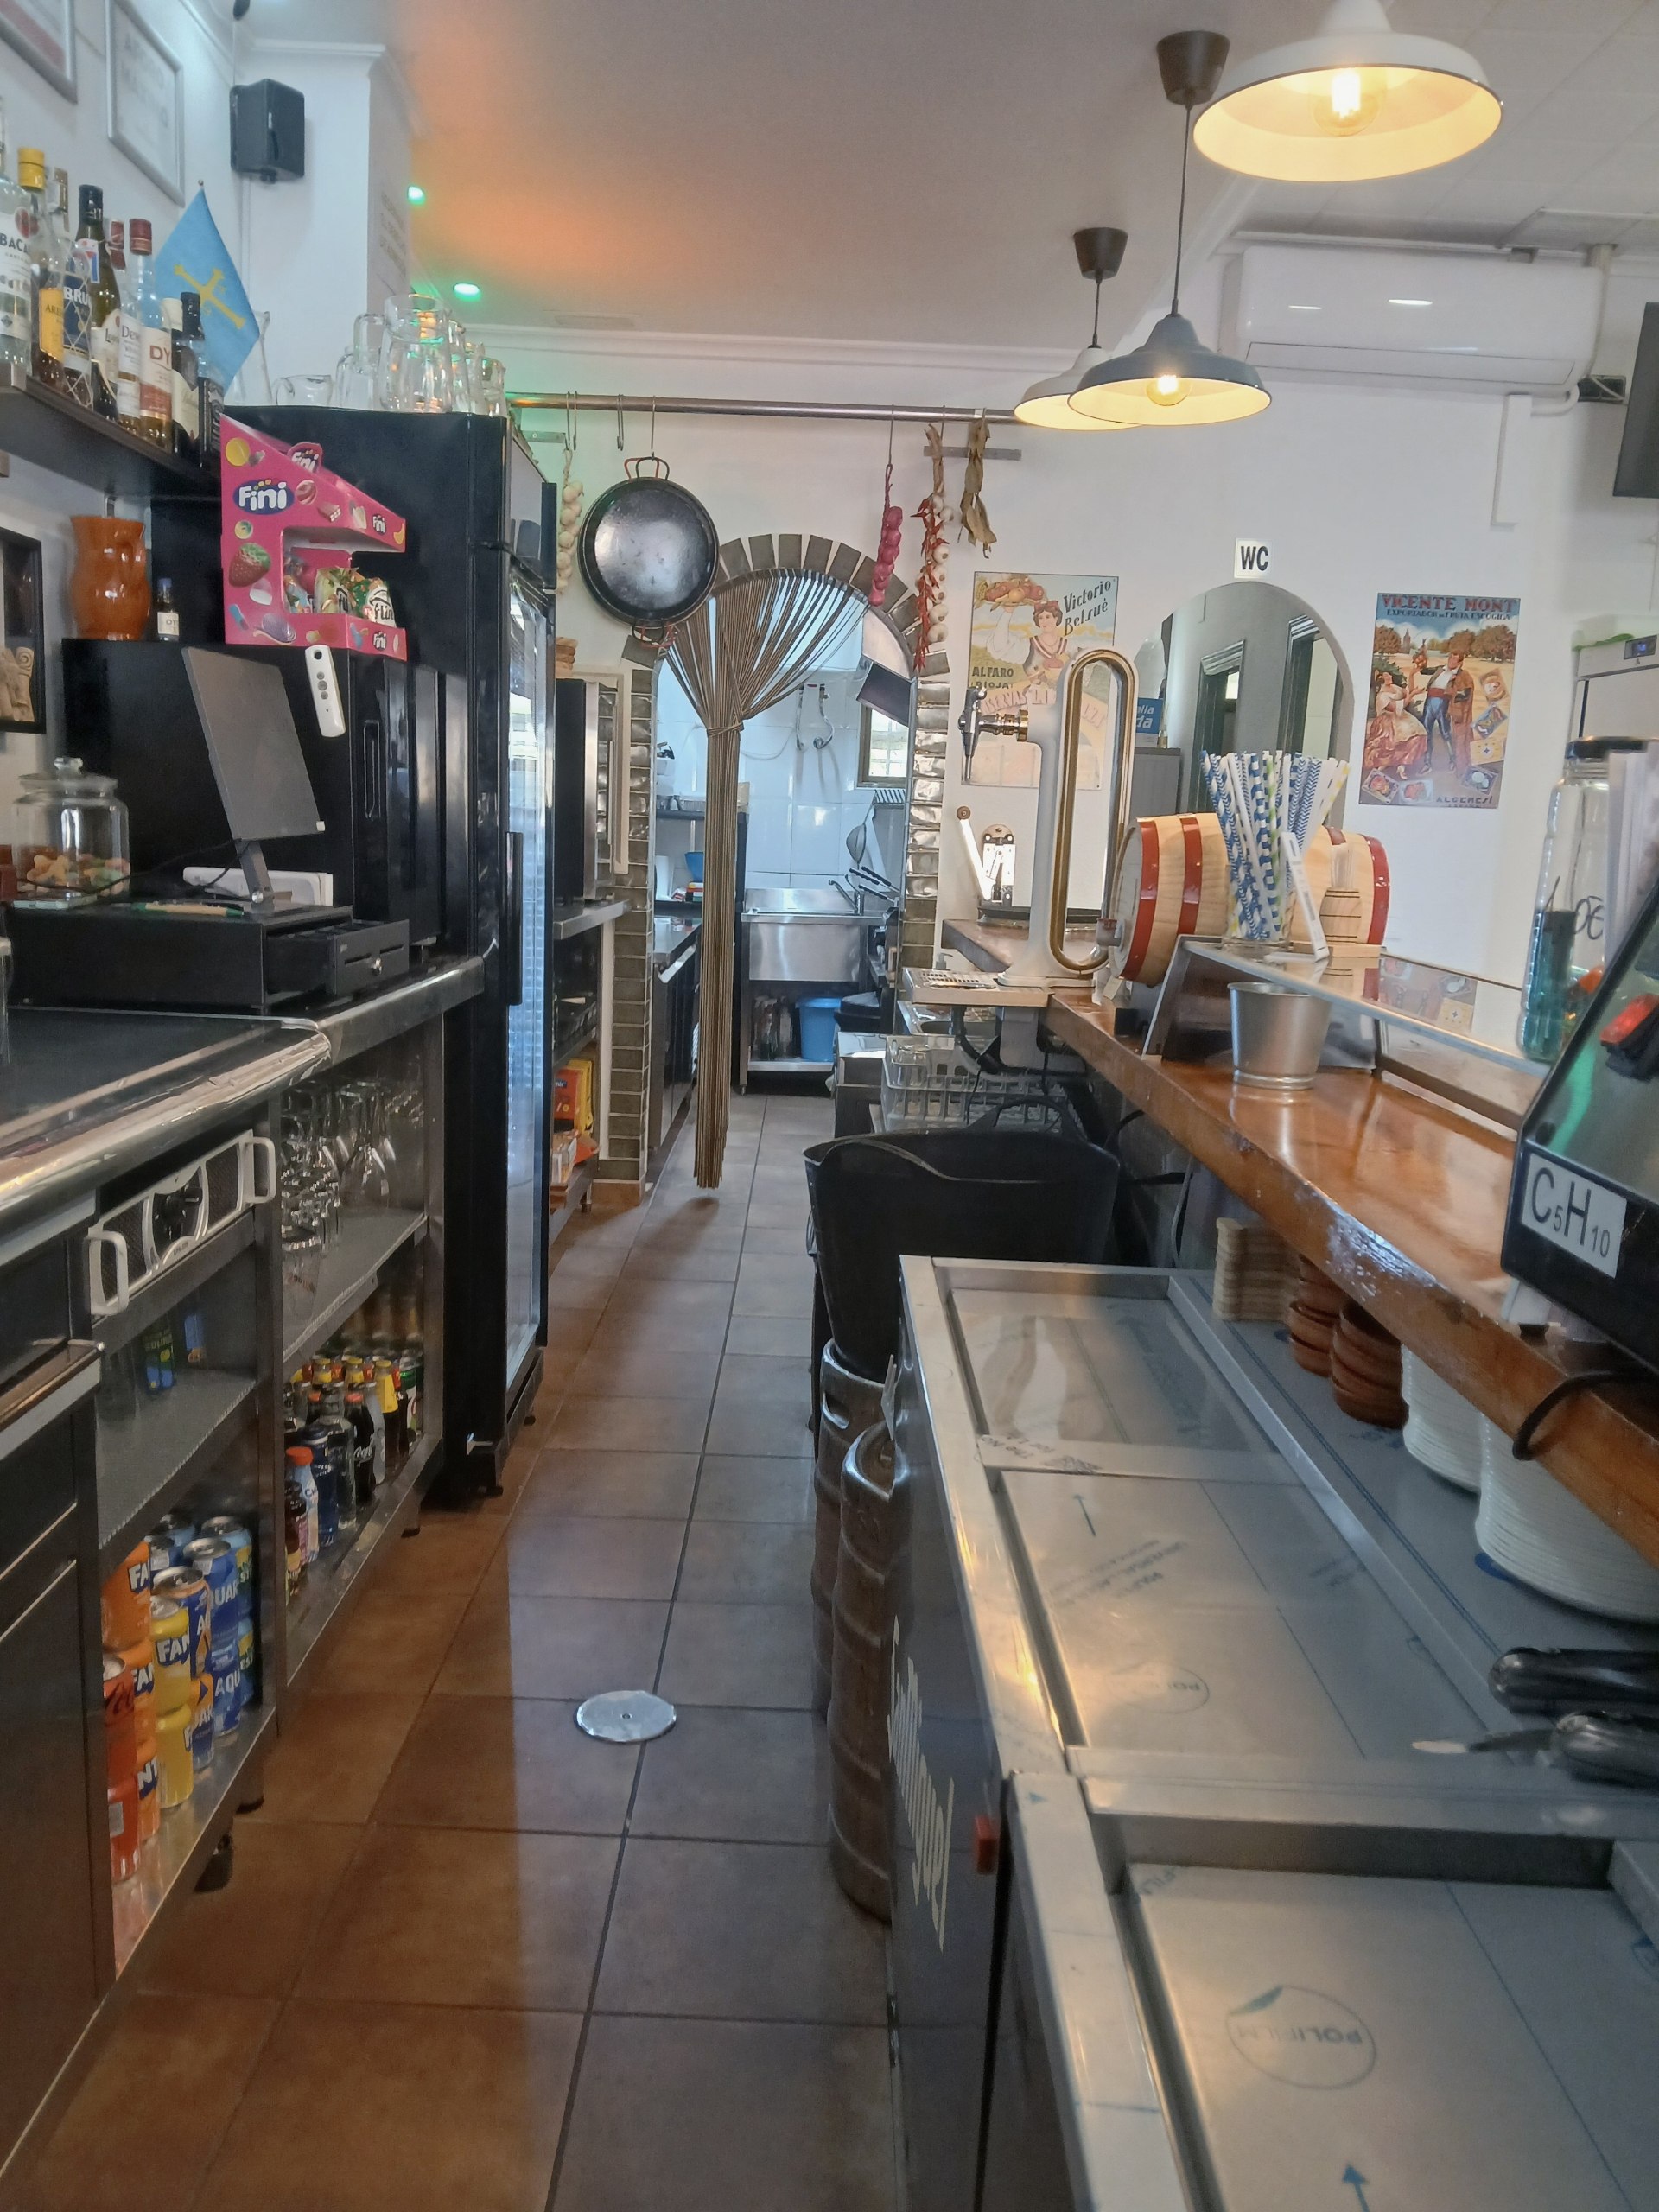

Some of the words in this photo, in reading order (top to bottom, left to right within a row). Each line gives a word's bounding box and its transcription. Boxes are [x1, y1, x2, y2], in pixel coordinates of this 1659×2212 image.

[149, 345, 172, 365] DY
[238, 480, 288, 511] Fini
[1241, 545, 1269, 571] WC
[1064, 581, 1111, 613] Victorio
[1382, 594, 1457, 611] VICENTE
[1464, 598, 1517, 613] MONT
[972, 666, 1014, 678] ALFARO
[128, 1560, 150, 1591] FA
[214, 1668, 241, 1697] AQU
